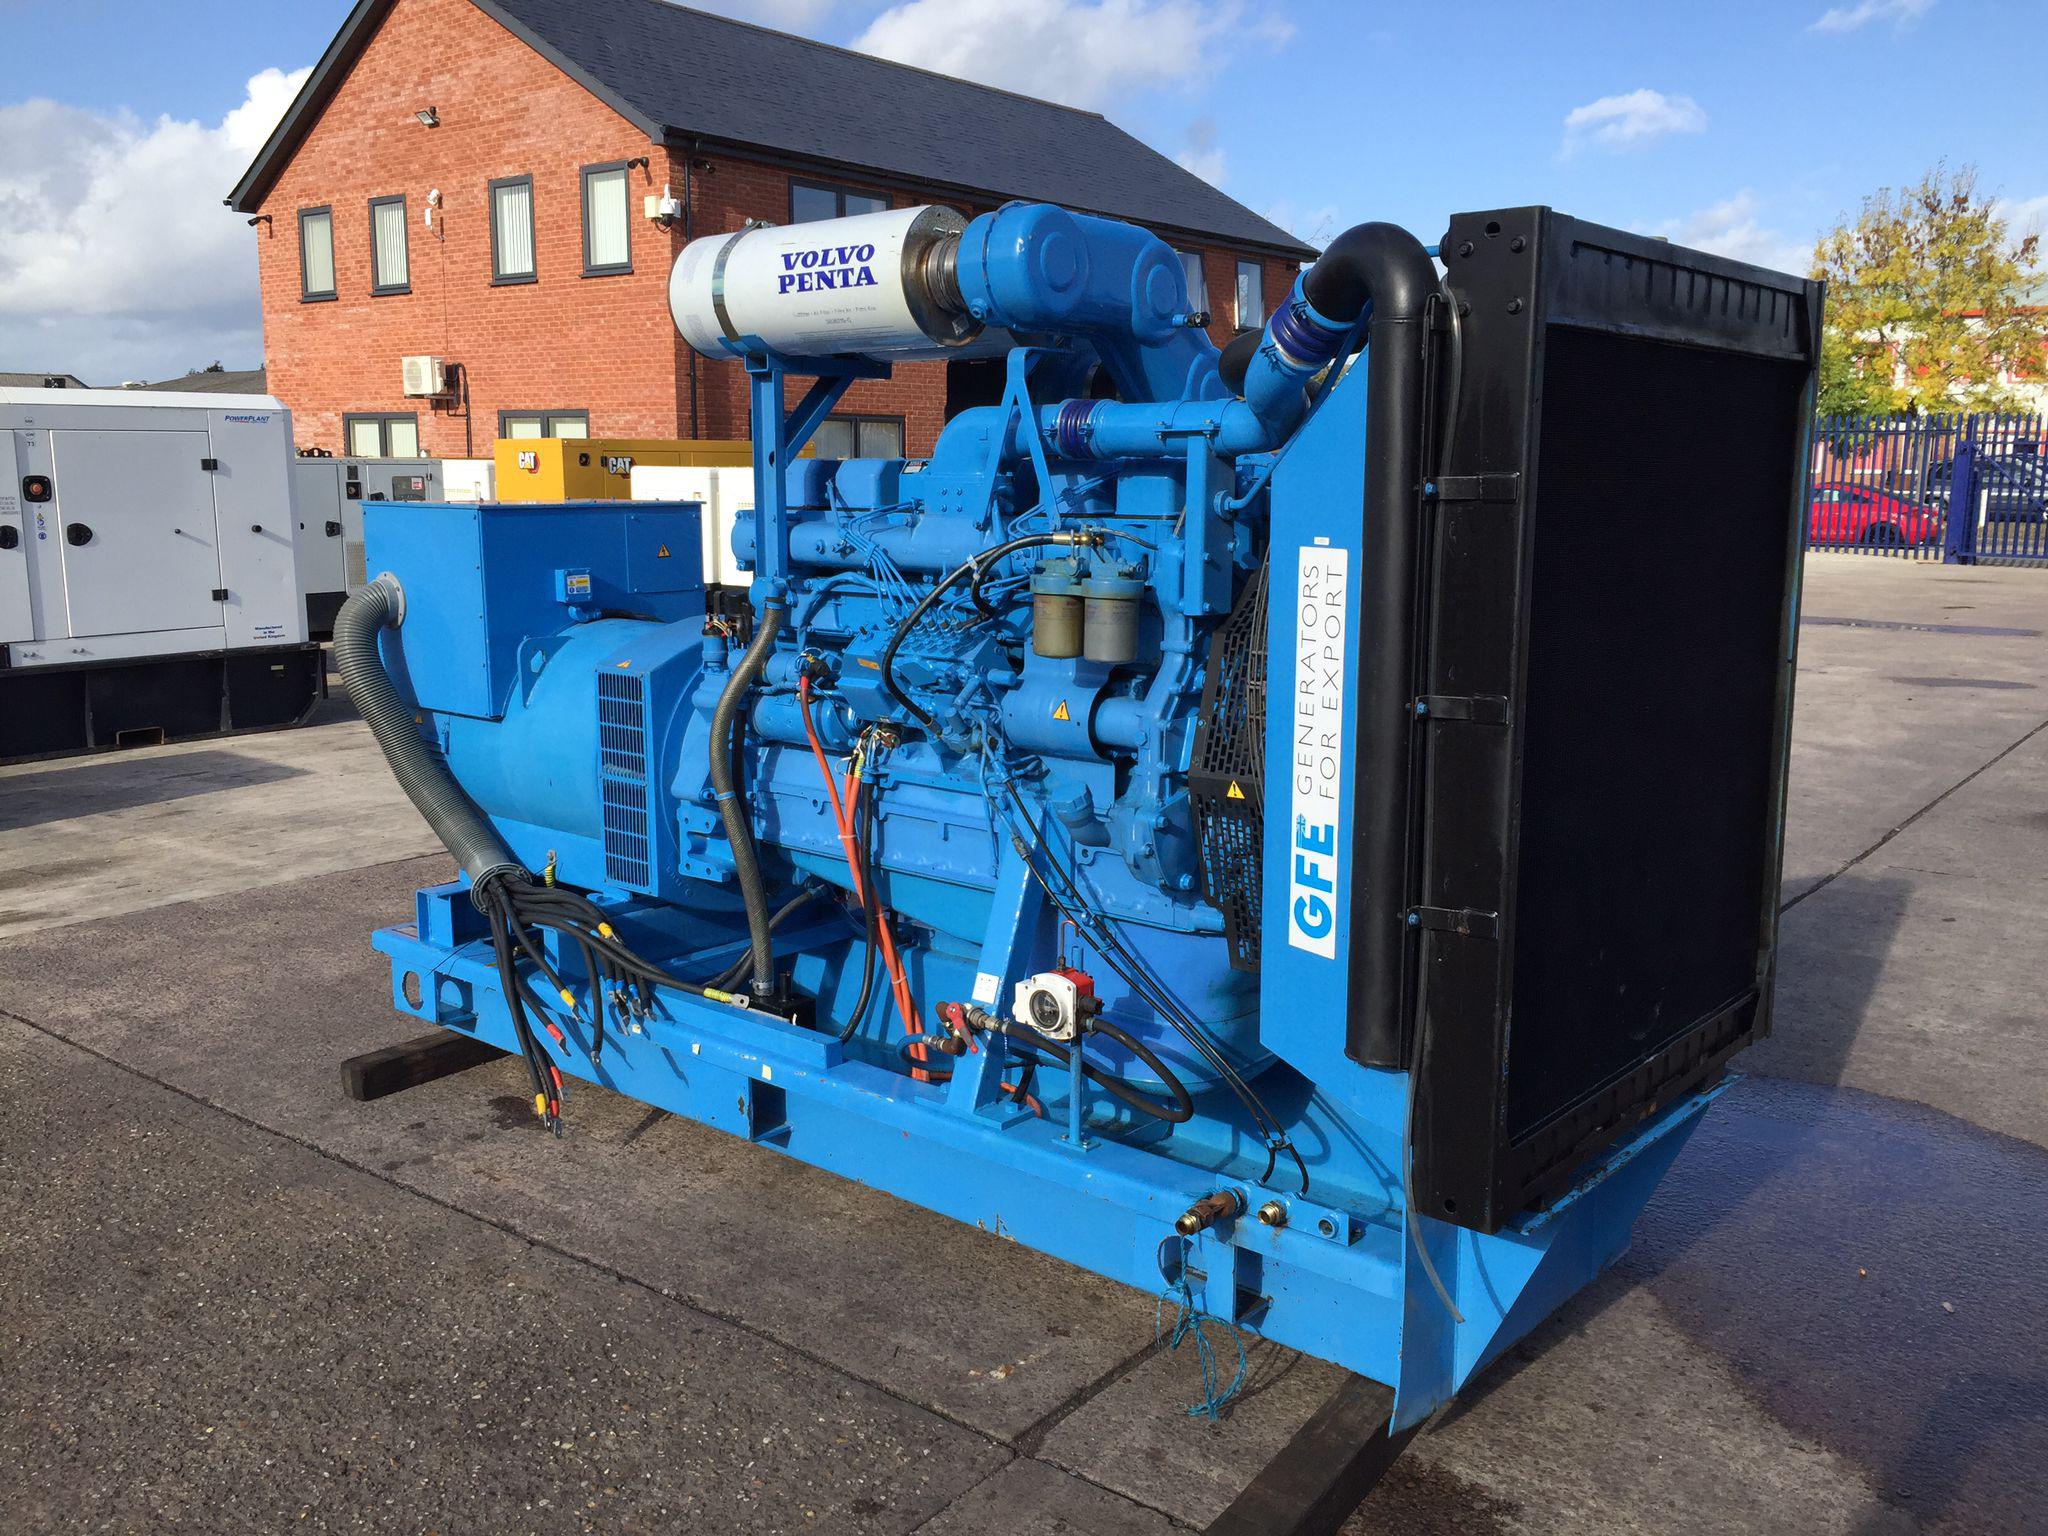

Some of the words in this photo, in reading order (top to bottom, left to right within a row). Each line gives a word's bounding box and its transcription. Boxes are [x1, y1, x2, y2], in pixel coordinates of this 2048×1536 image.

[778, 266, 878, 294] PENTA
[781, 244, 875, 271] VOLVO
[518, 452, 535, 469] CAT
[608, 457, 631, 474] CAT
[1321, 565, 1343, 710] EXPORT
[1296, 565, 1320, 795] GENERATORS
[1319, 732, 1337, 800] FOR
[1294, 813, 1334, 939] GFE
